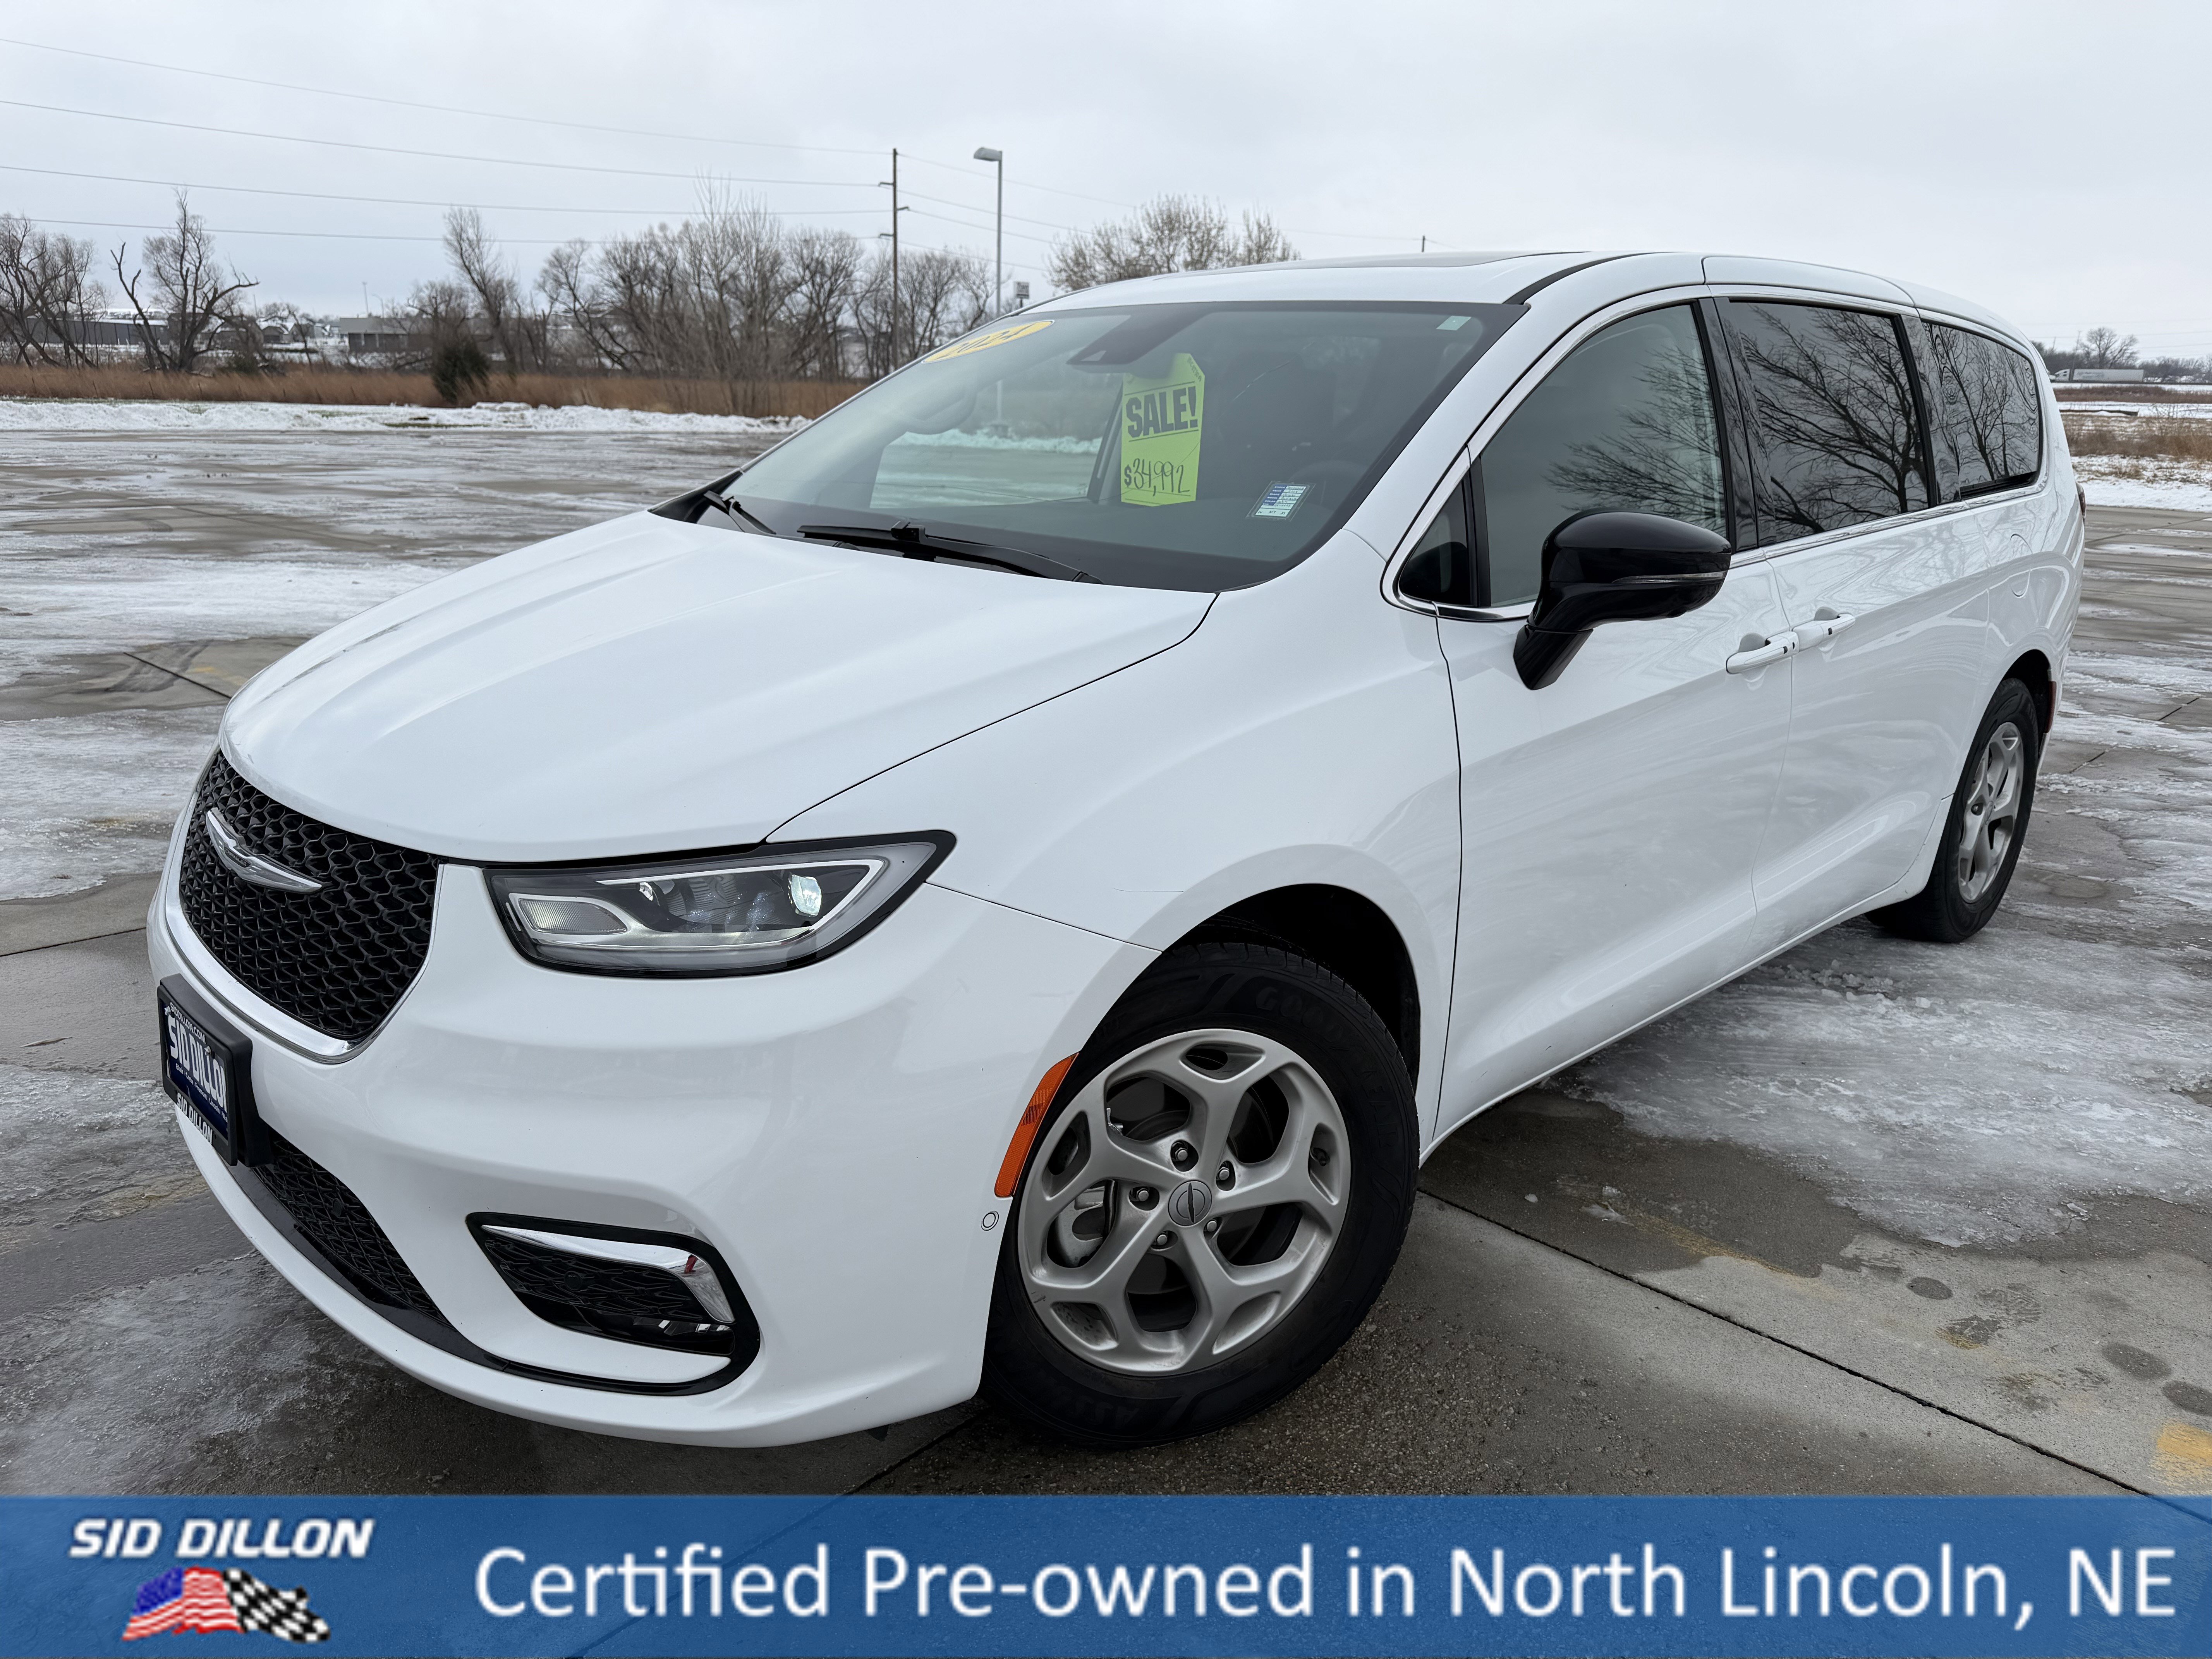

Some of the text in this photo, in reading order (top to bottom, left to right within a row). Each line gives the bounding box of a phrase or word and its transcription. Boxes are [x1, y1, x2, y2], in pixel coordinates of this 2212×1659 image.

[1126, 386, 1198, 438] SALE!
[1124, 458, 1190, 496] $34,992
[225, 848, 247, 866] CHRYSLER
[168, 1014, 190, 1072] SID
[177, 1092, 213, 1145] SID DILLON
